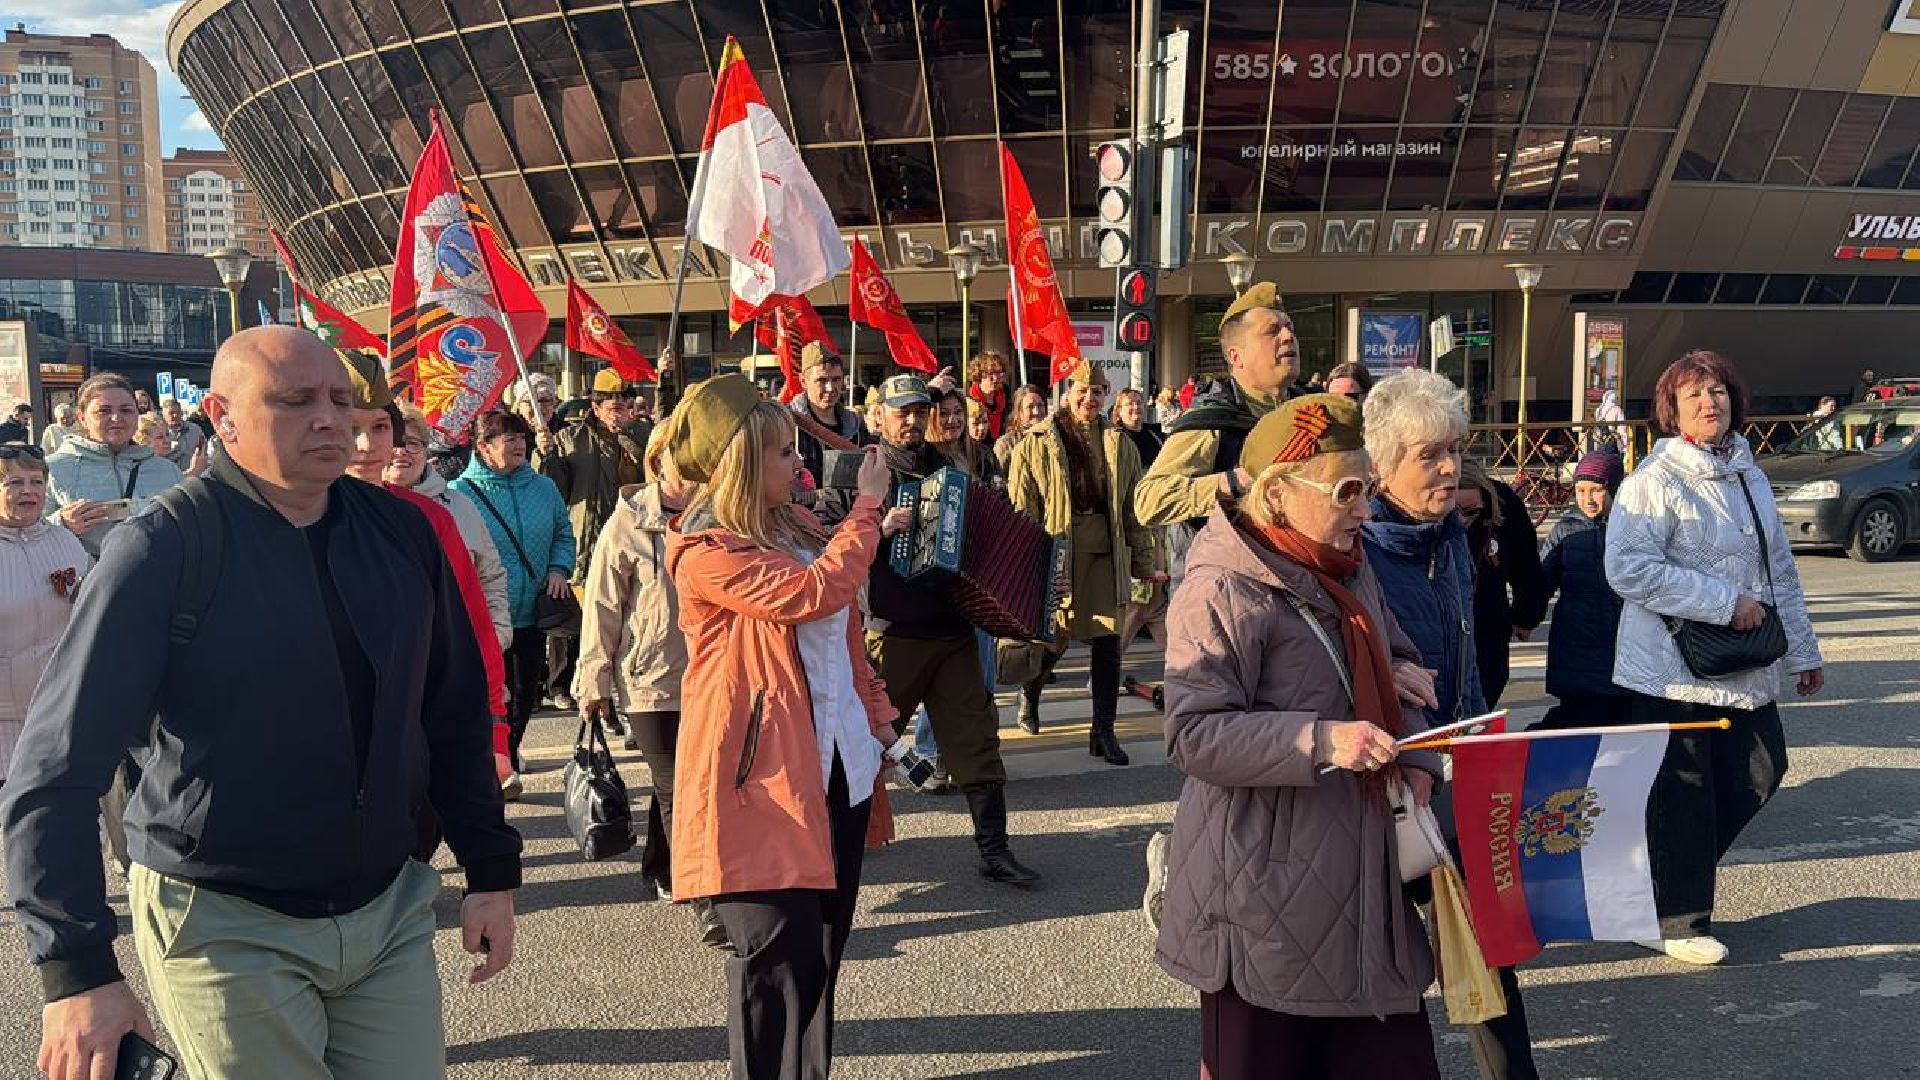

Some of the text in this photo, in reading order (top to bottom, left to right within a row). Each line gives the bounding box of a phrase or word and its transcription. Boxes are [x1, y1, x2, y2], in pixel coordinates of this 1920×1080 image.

[1214, 53, 1269, 79] 585
[1205, 217, 1633, 254] КОМПЛЕКС
[1489, 792, 1513, 892] РОССИЯ
